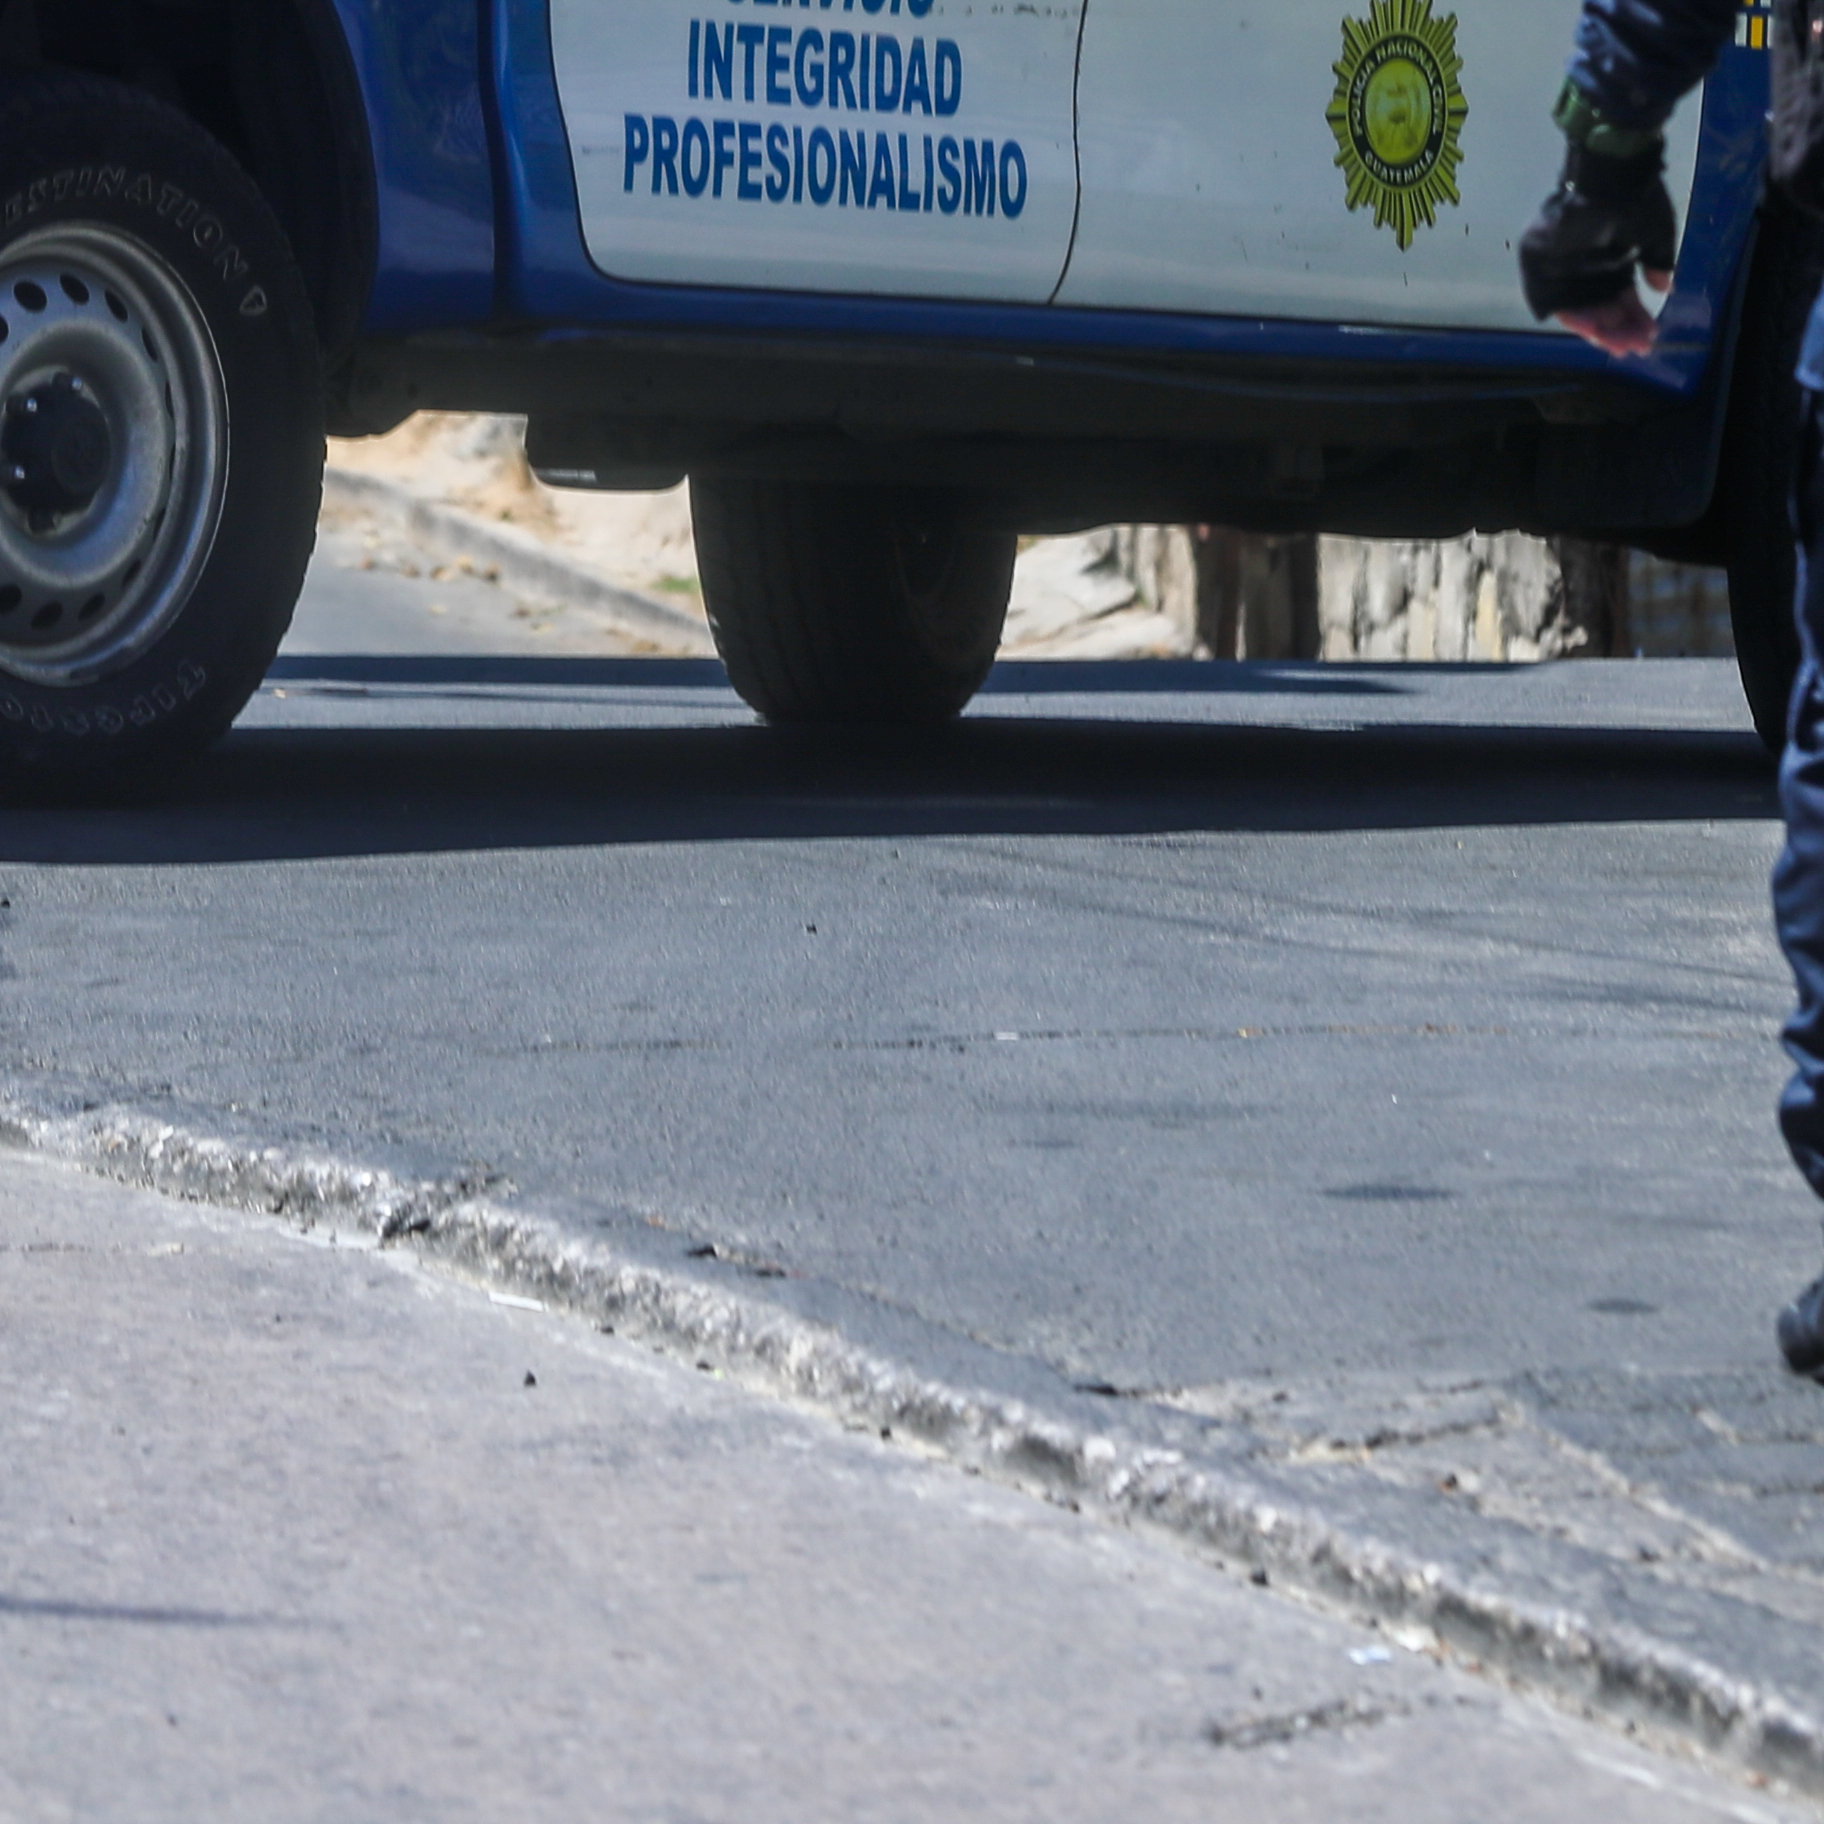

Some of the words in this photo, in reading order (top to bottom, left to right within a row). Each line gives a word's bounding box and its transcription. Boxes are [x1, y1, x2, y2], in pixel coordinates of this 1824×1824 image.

[687, 18, 963, 117] INTEGRIDAD
[623, 112, 1028, 220] PROFESIONALISMO
[1364, 149, 1435, 185] GUATEMALA
